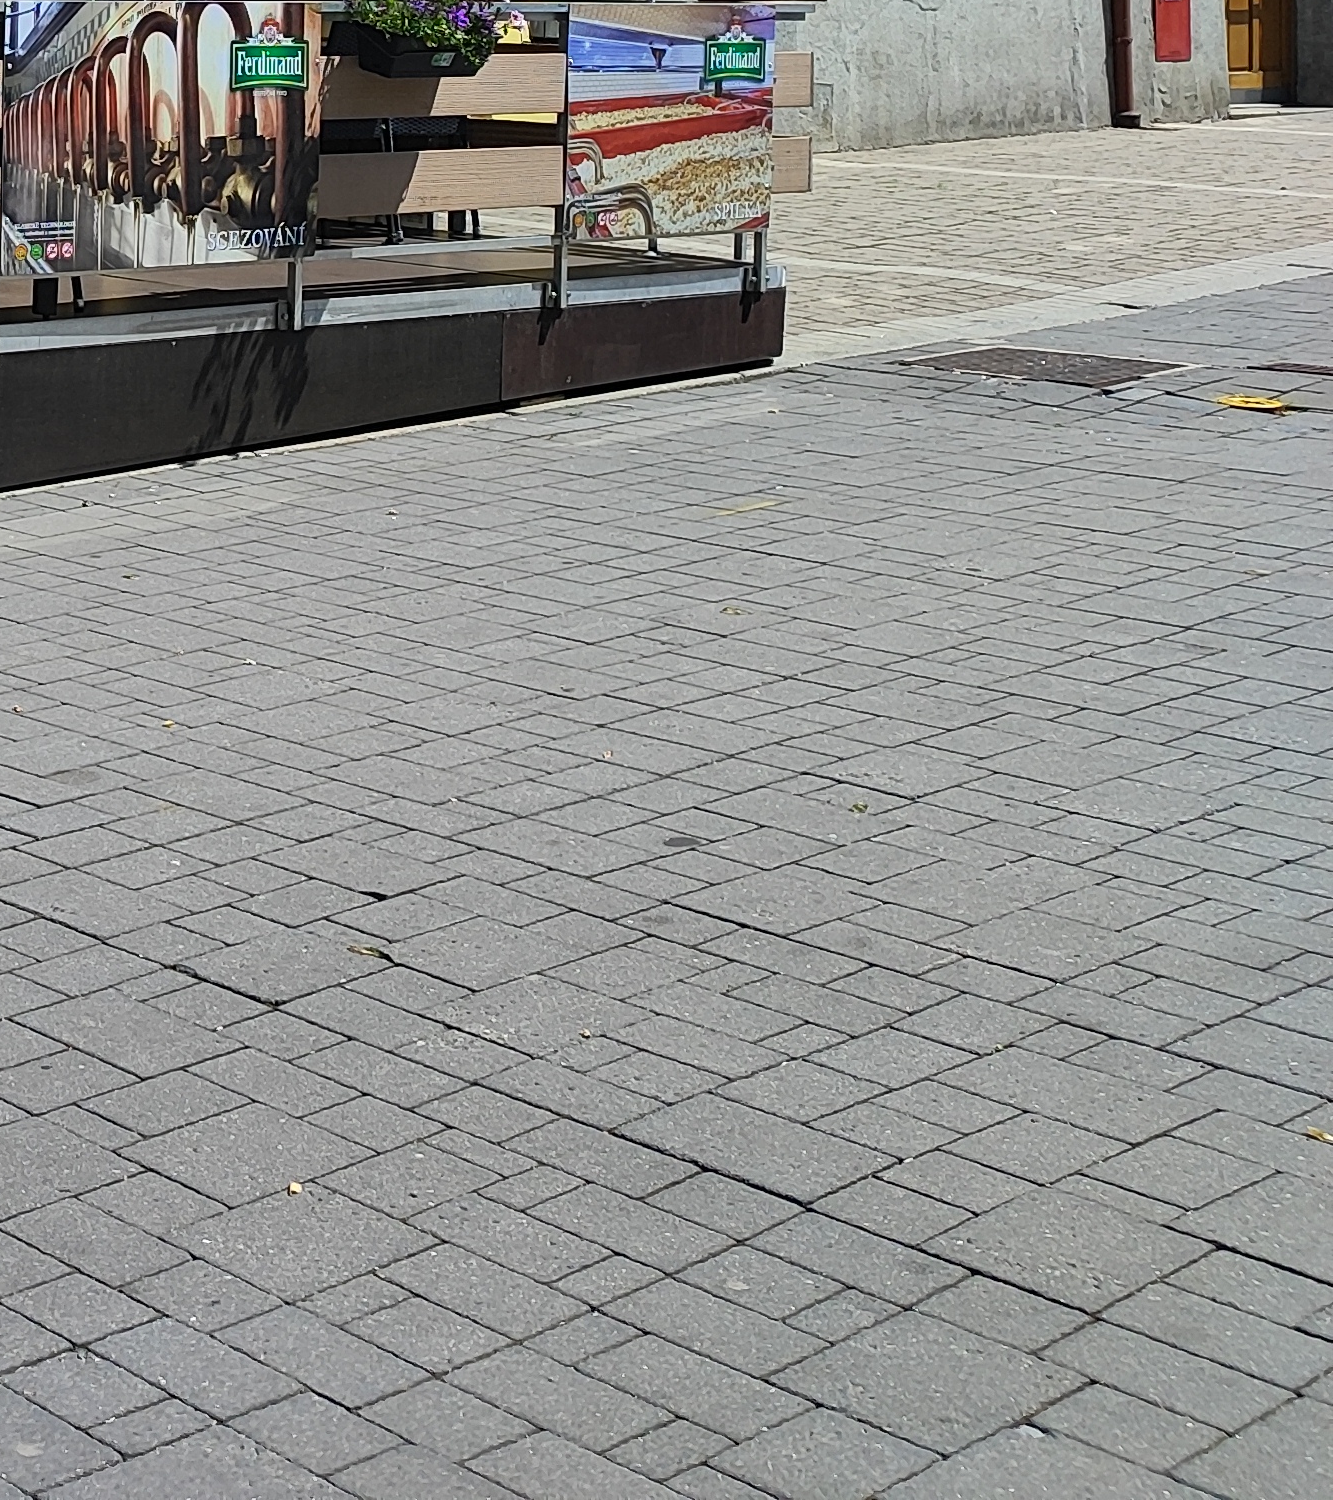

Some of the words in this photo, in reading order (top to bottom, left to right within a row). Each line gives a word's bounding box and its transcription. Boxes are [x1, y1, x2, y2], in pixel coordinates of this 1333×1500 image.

[236, 50, 303, 76] Ferdinand
[709, 46, 761, 71] Ferdinand
[714, 200, 762, 220] SPILKA
[207, 220, 307, 251] SCEZOVÁNÍ
